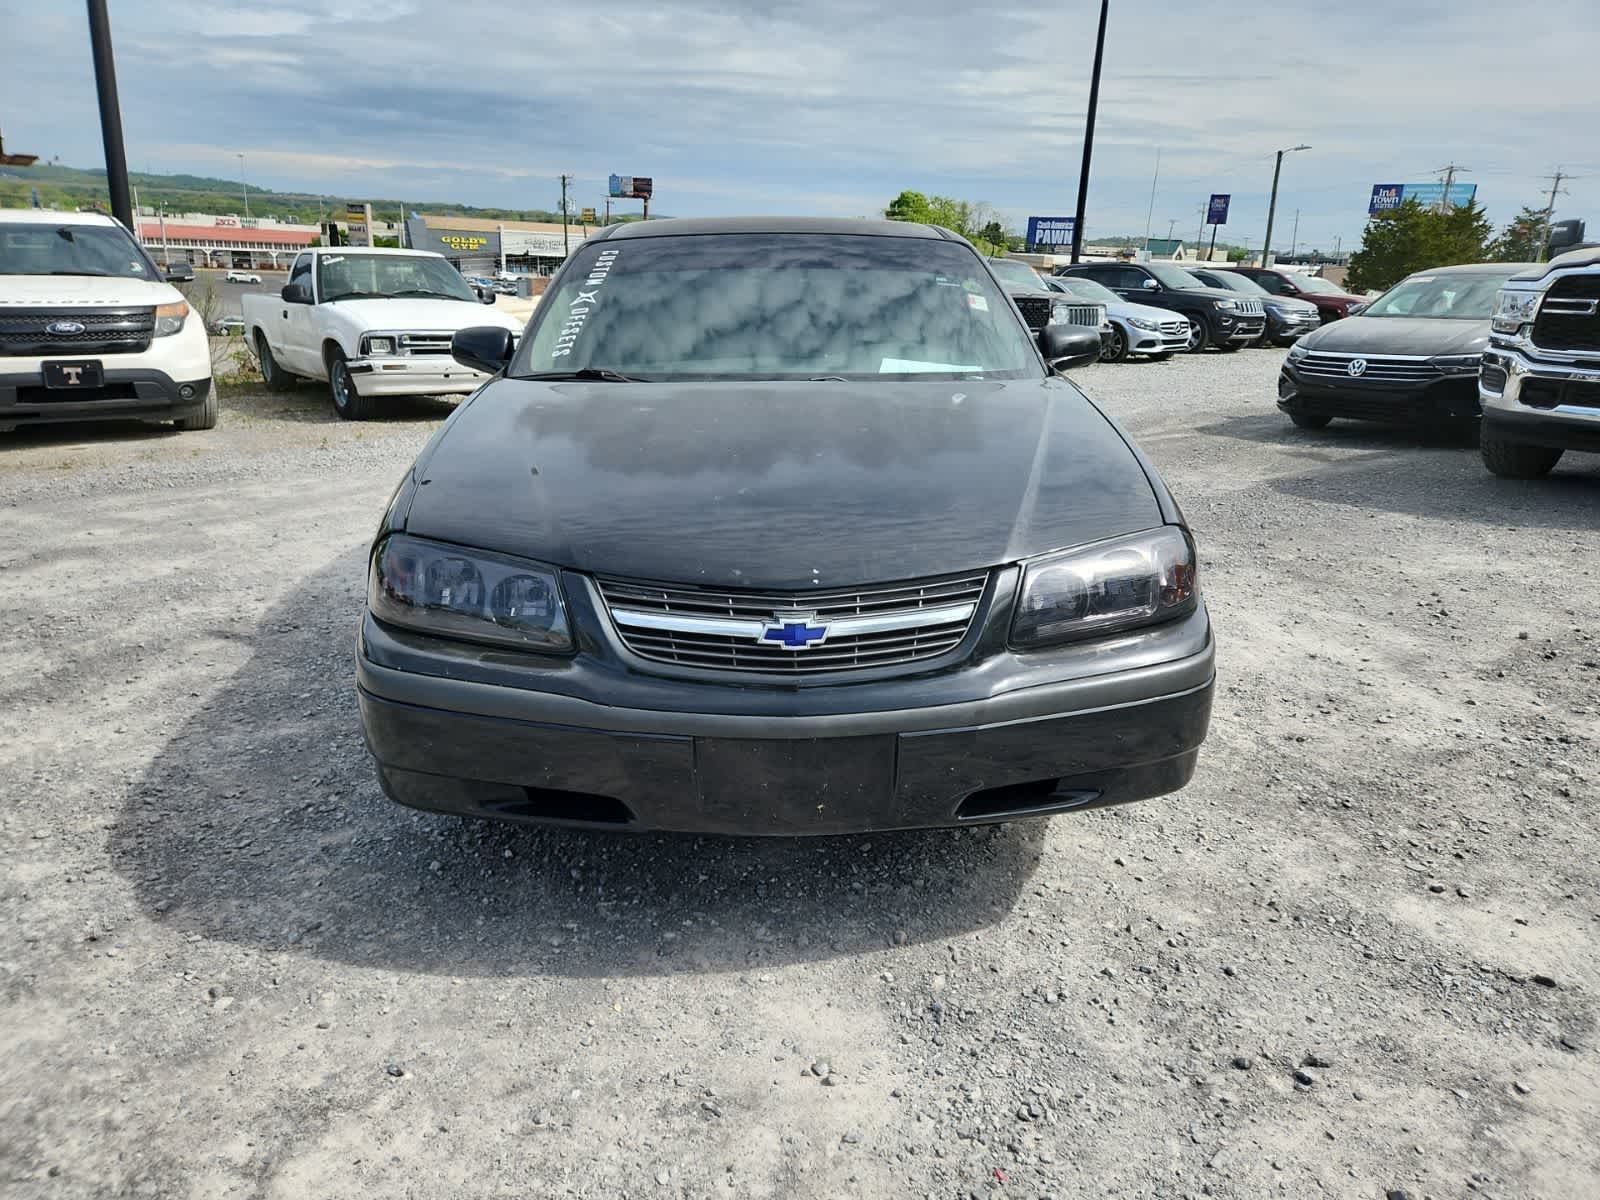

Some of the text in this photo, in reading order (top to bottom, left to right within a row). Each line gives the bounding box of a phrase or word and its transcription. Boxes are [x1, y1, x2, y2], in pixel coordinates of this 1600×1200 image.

[1373, 195, 1399, 204] Town
[1035, 229, 1073, 245] PAWN
[585, 250, 620, 286] CUSTOM
[551, 307, 590, 358] OFFSETS
